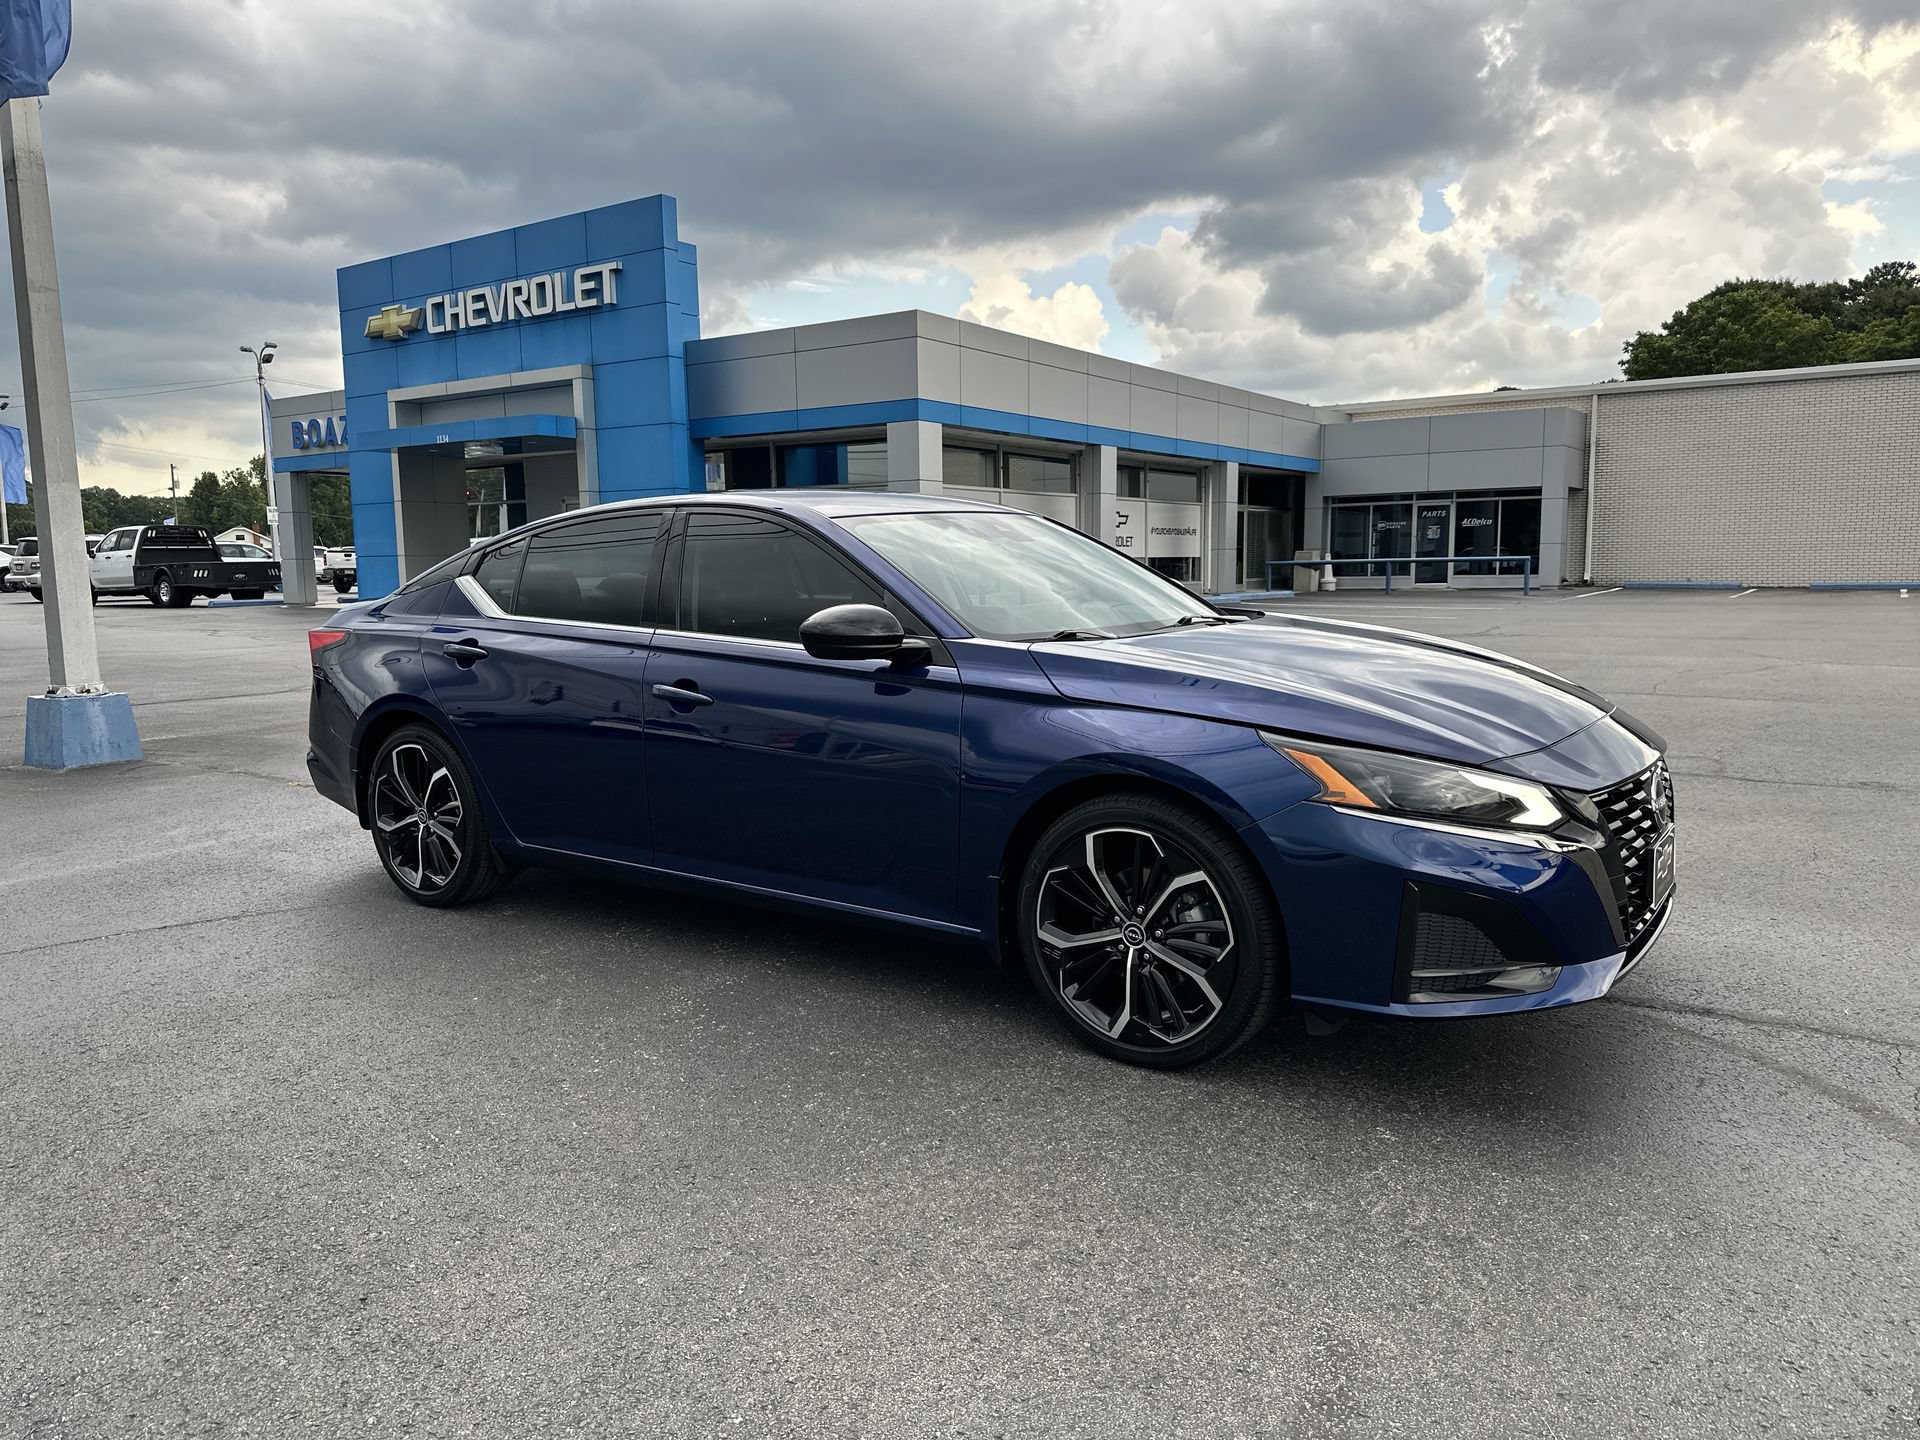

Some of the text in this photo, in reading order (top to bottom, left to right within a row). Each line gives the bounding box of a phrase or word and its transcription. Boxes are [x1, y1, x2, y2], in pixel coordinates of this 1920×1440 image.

[425, 261, 622, 334] CHEVROLET
[436, 434, 449, 443] 1134
[1422, 510, 1446, 518] PARTS
[1461, 518, 1493, 526] ACDelco
